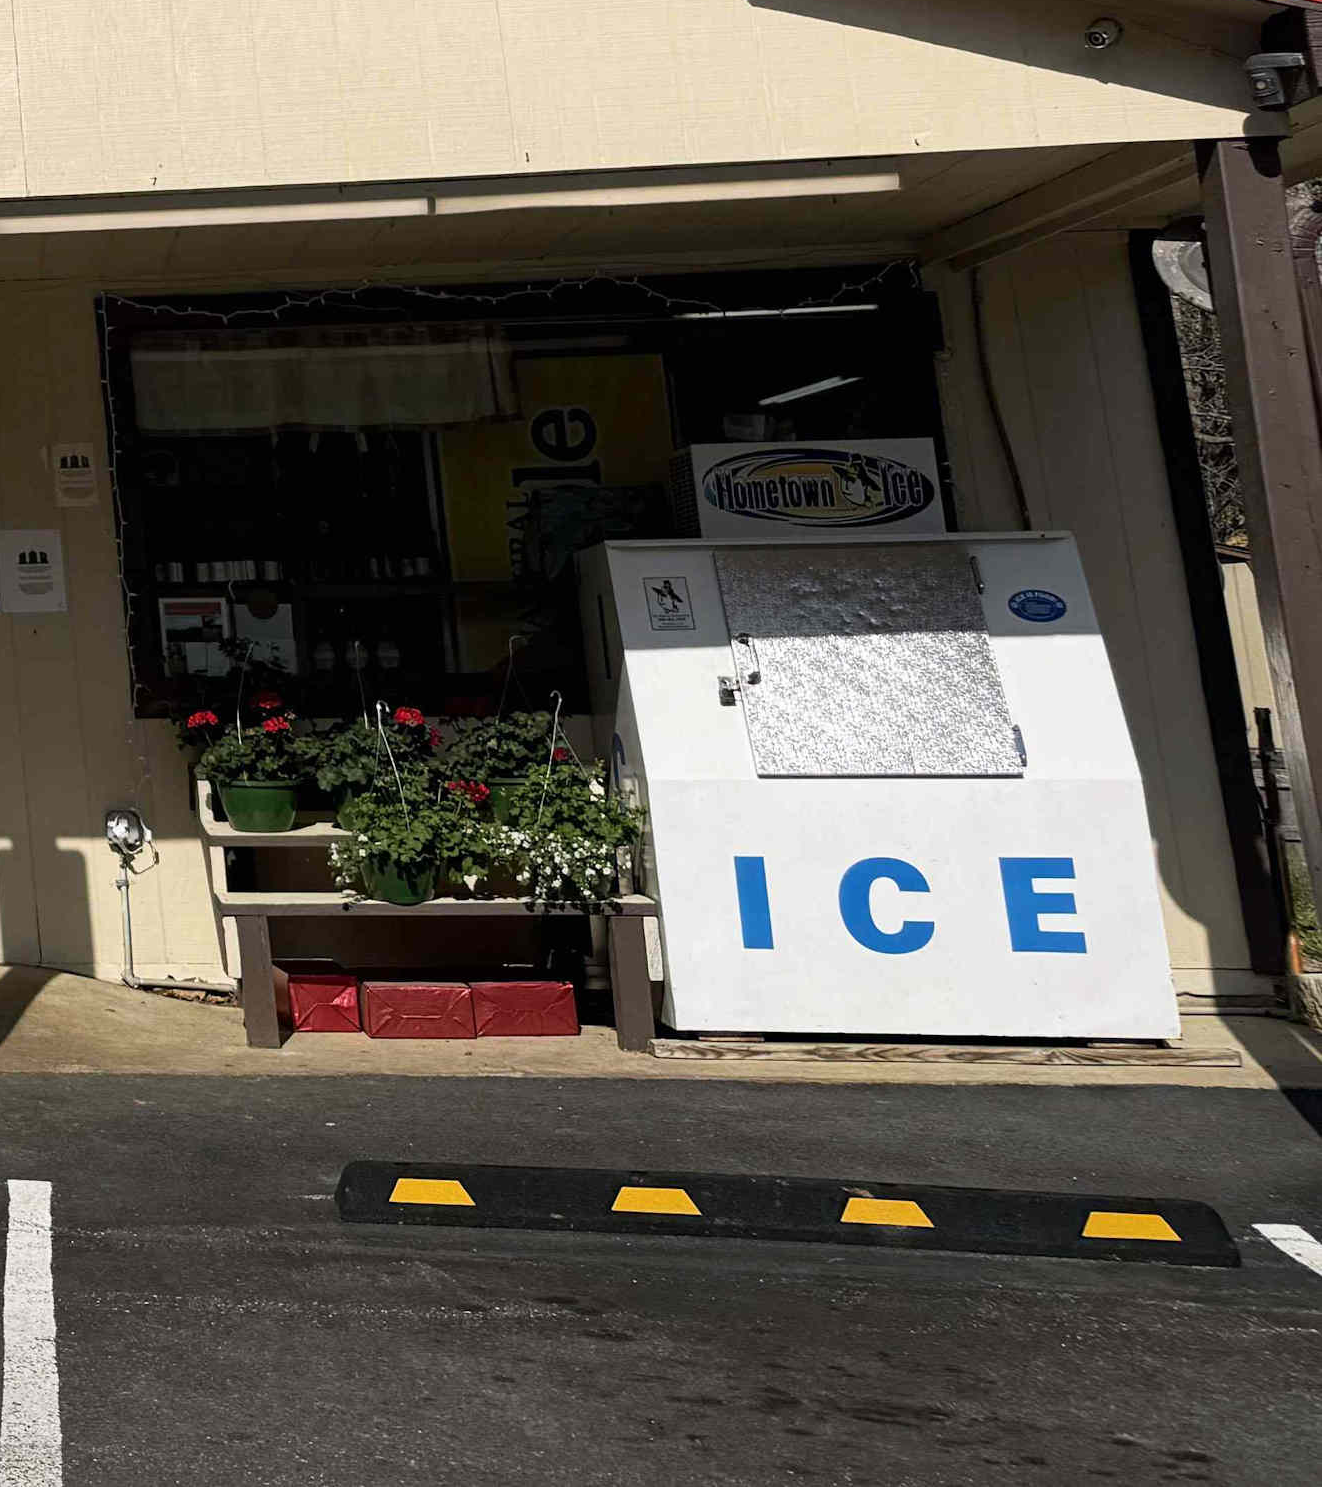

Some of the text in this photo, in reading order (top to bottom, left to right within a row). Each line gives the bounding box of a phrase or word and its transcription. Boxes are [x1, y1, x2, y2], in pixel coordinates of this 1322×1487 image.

[715, 464, 925, 510] Hometown Ice
[734, 857, 1088, 955] ICE
